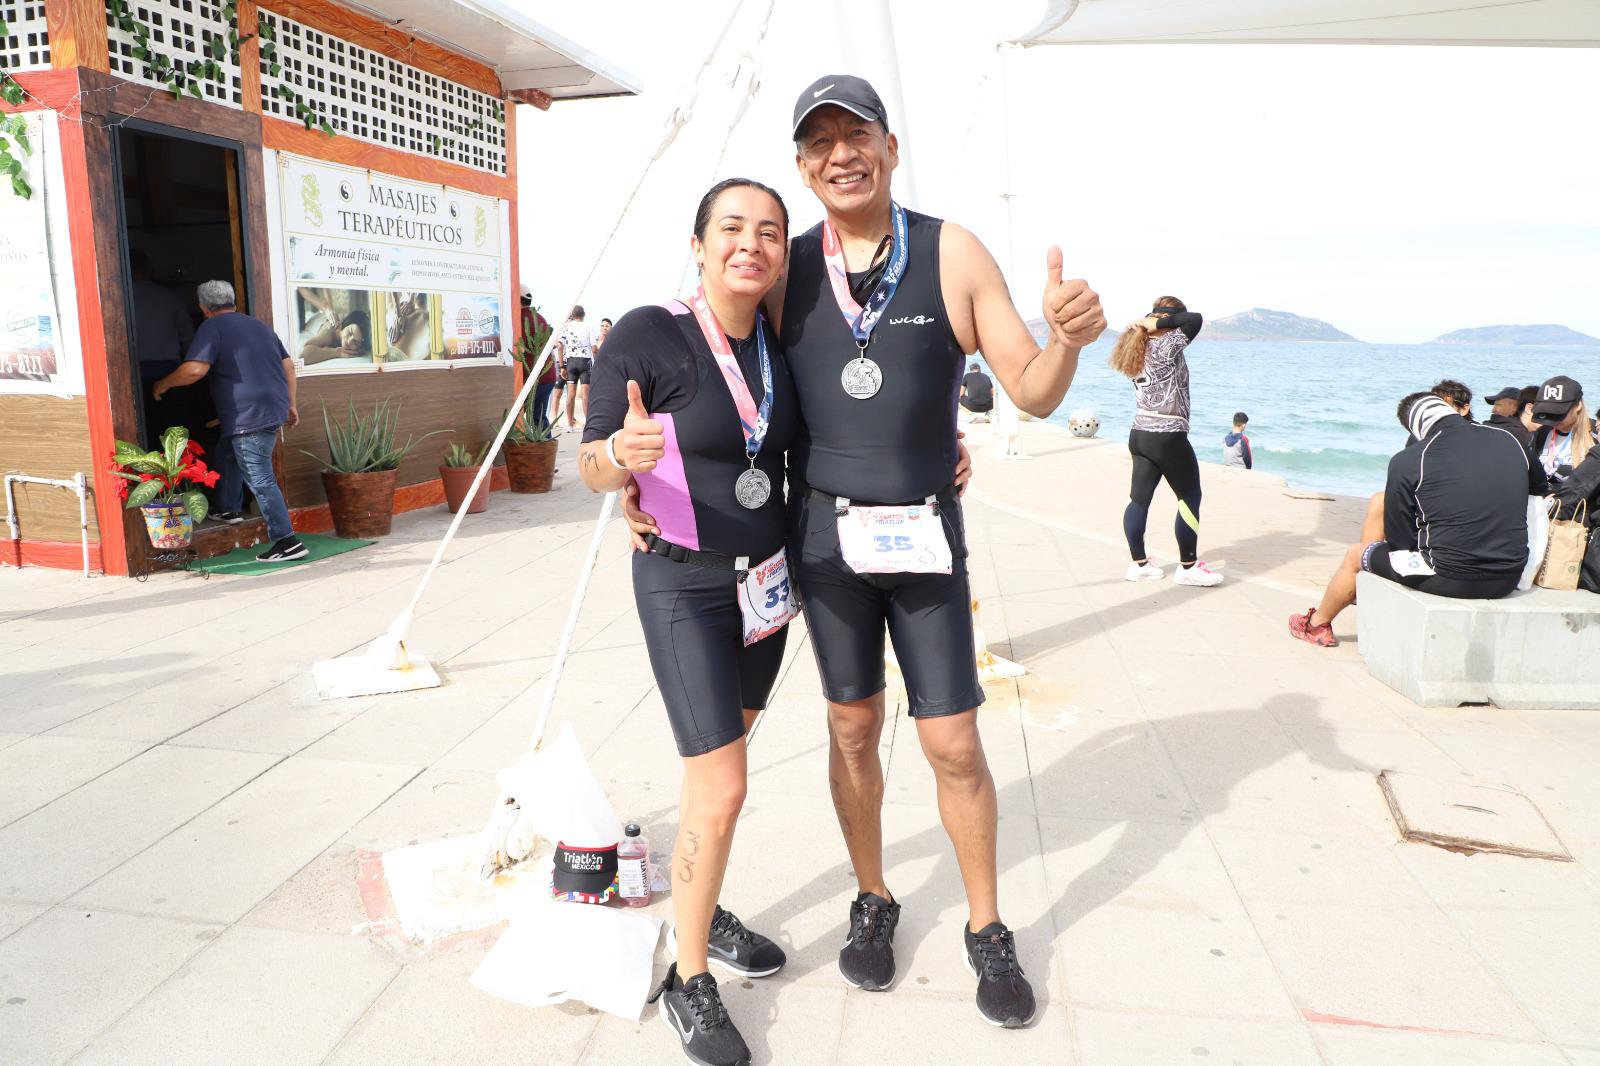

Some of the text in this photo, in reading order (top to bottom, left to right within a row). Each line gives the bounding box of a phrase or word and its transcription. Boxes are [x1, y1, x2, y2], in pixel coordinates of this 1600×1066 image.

[369, 185, 437, 215] MASAJES
[338, 211, 462, 245] TERAPÉUTICOS
[315, 244, 380, 264] Armonía física
[329, 264, 369, 278] y mental.
[873, 535, 914, 553] 35
[765, 578, 789, 608] 33
